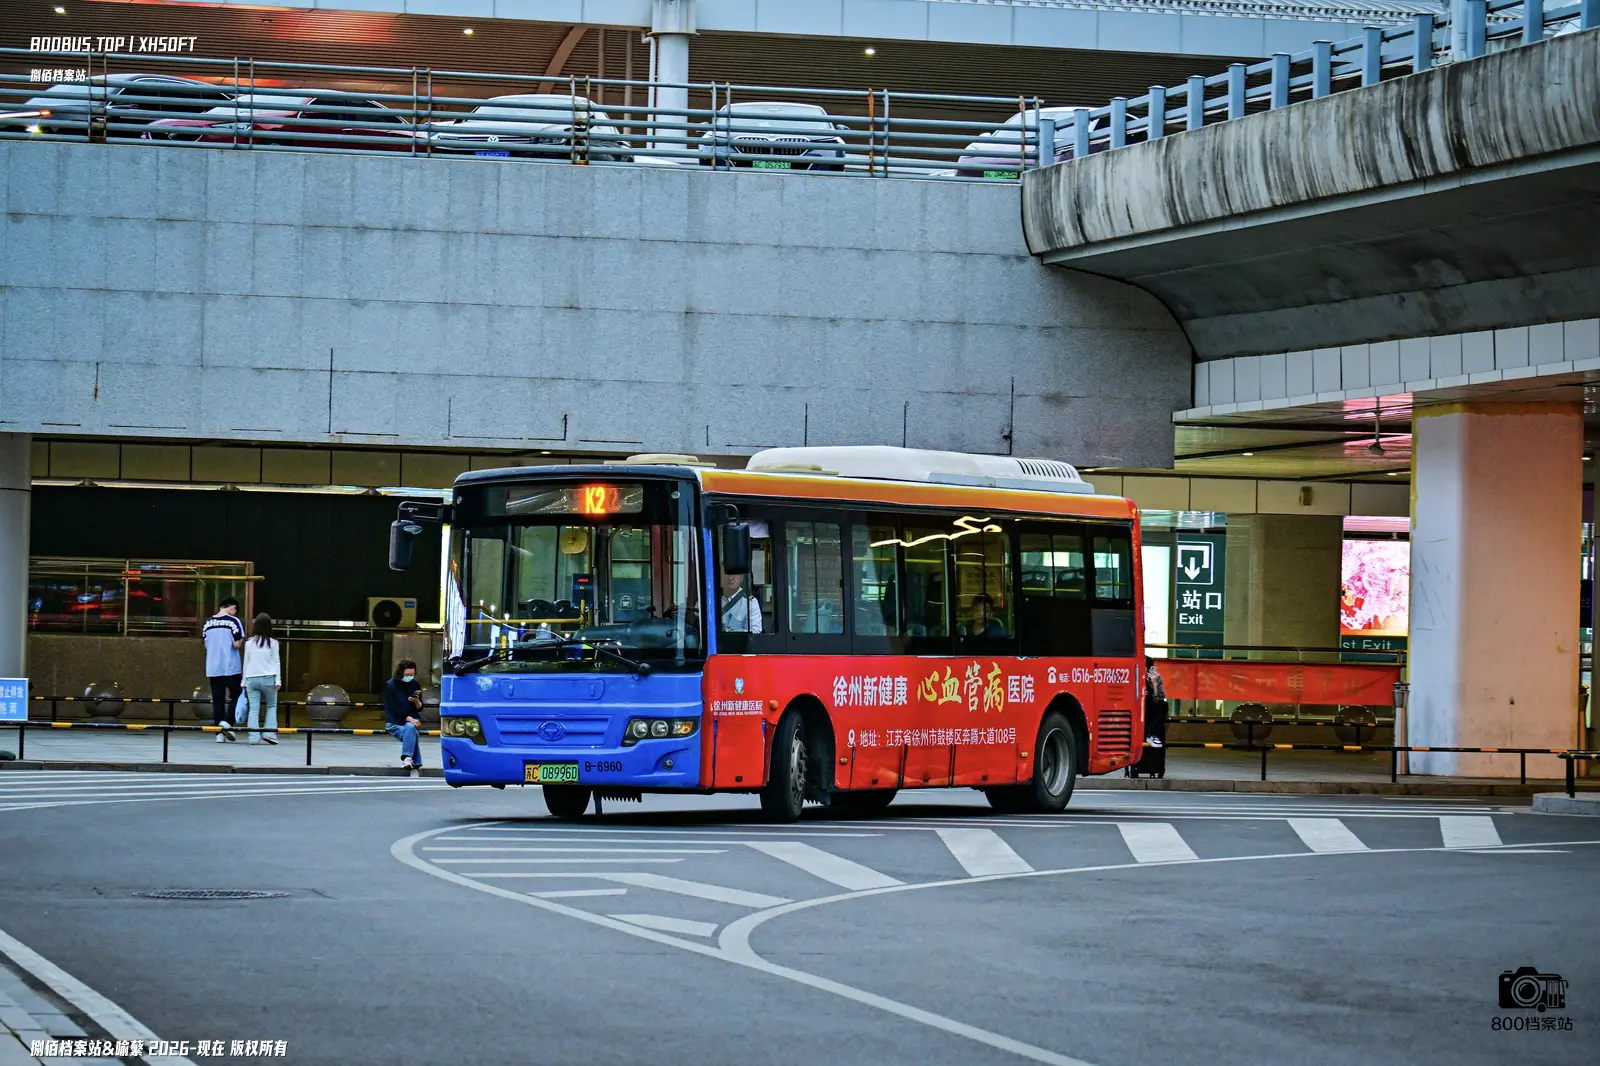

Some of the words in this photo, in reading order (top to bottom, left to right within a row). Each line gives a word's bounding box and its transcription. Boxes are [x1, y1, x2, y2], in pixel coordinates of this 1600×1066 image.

[585, 486, 606, 515] K2
[1176, 590, 1222, 610] 站口
[1179, 613, 1204, 625] Exit
[833, 675, 908, 707] 徐州新健康
[916, 660, 1005, 713] 心血管病
[1007, 674, 1035, 703] 医院
[713, 700, 764, 711] 徐州新健康医院
[584, 761, 623, 772] B-6960
